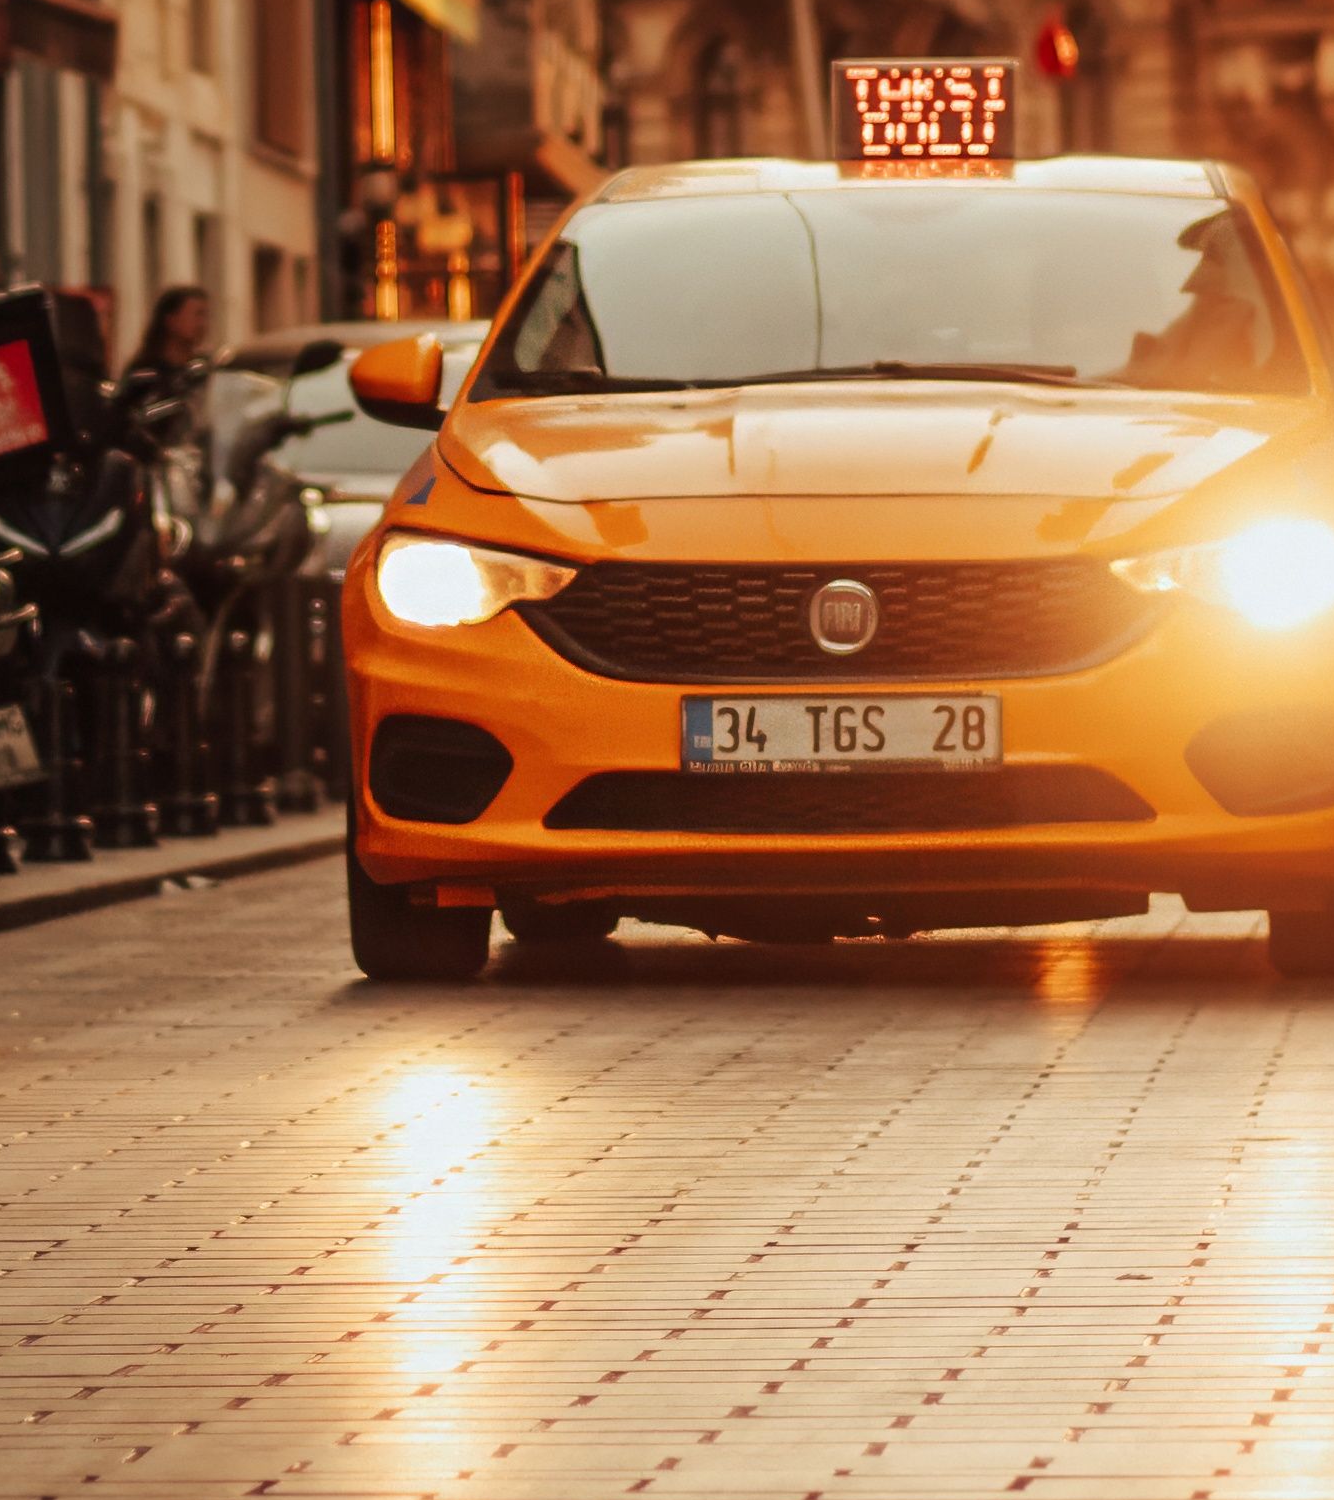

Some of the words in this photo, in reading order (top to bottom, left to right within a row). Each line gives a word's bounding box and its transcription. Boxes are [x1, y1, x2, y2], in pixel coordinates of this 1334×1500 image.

[716, 705, 767, 753] 34
[805, 704, 886, 753] TGS
[932, 704, 986, 752] 28
